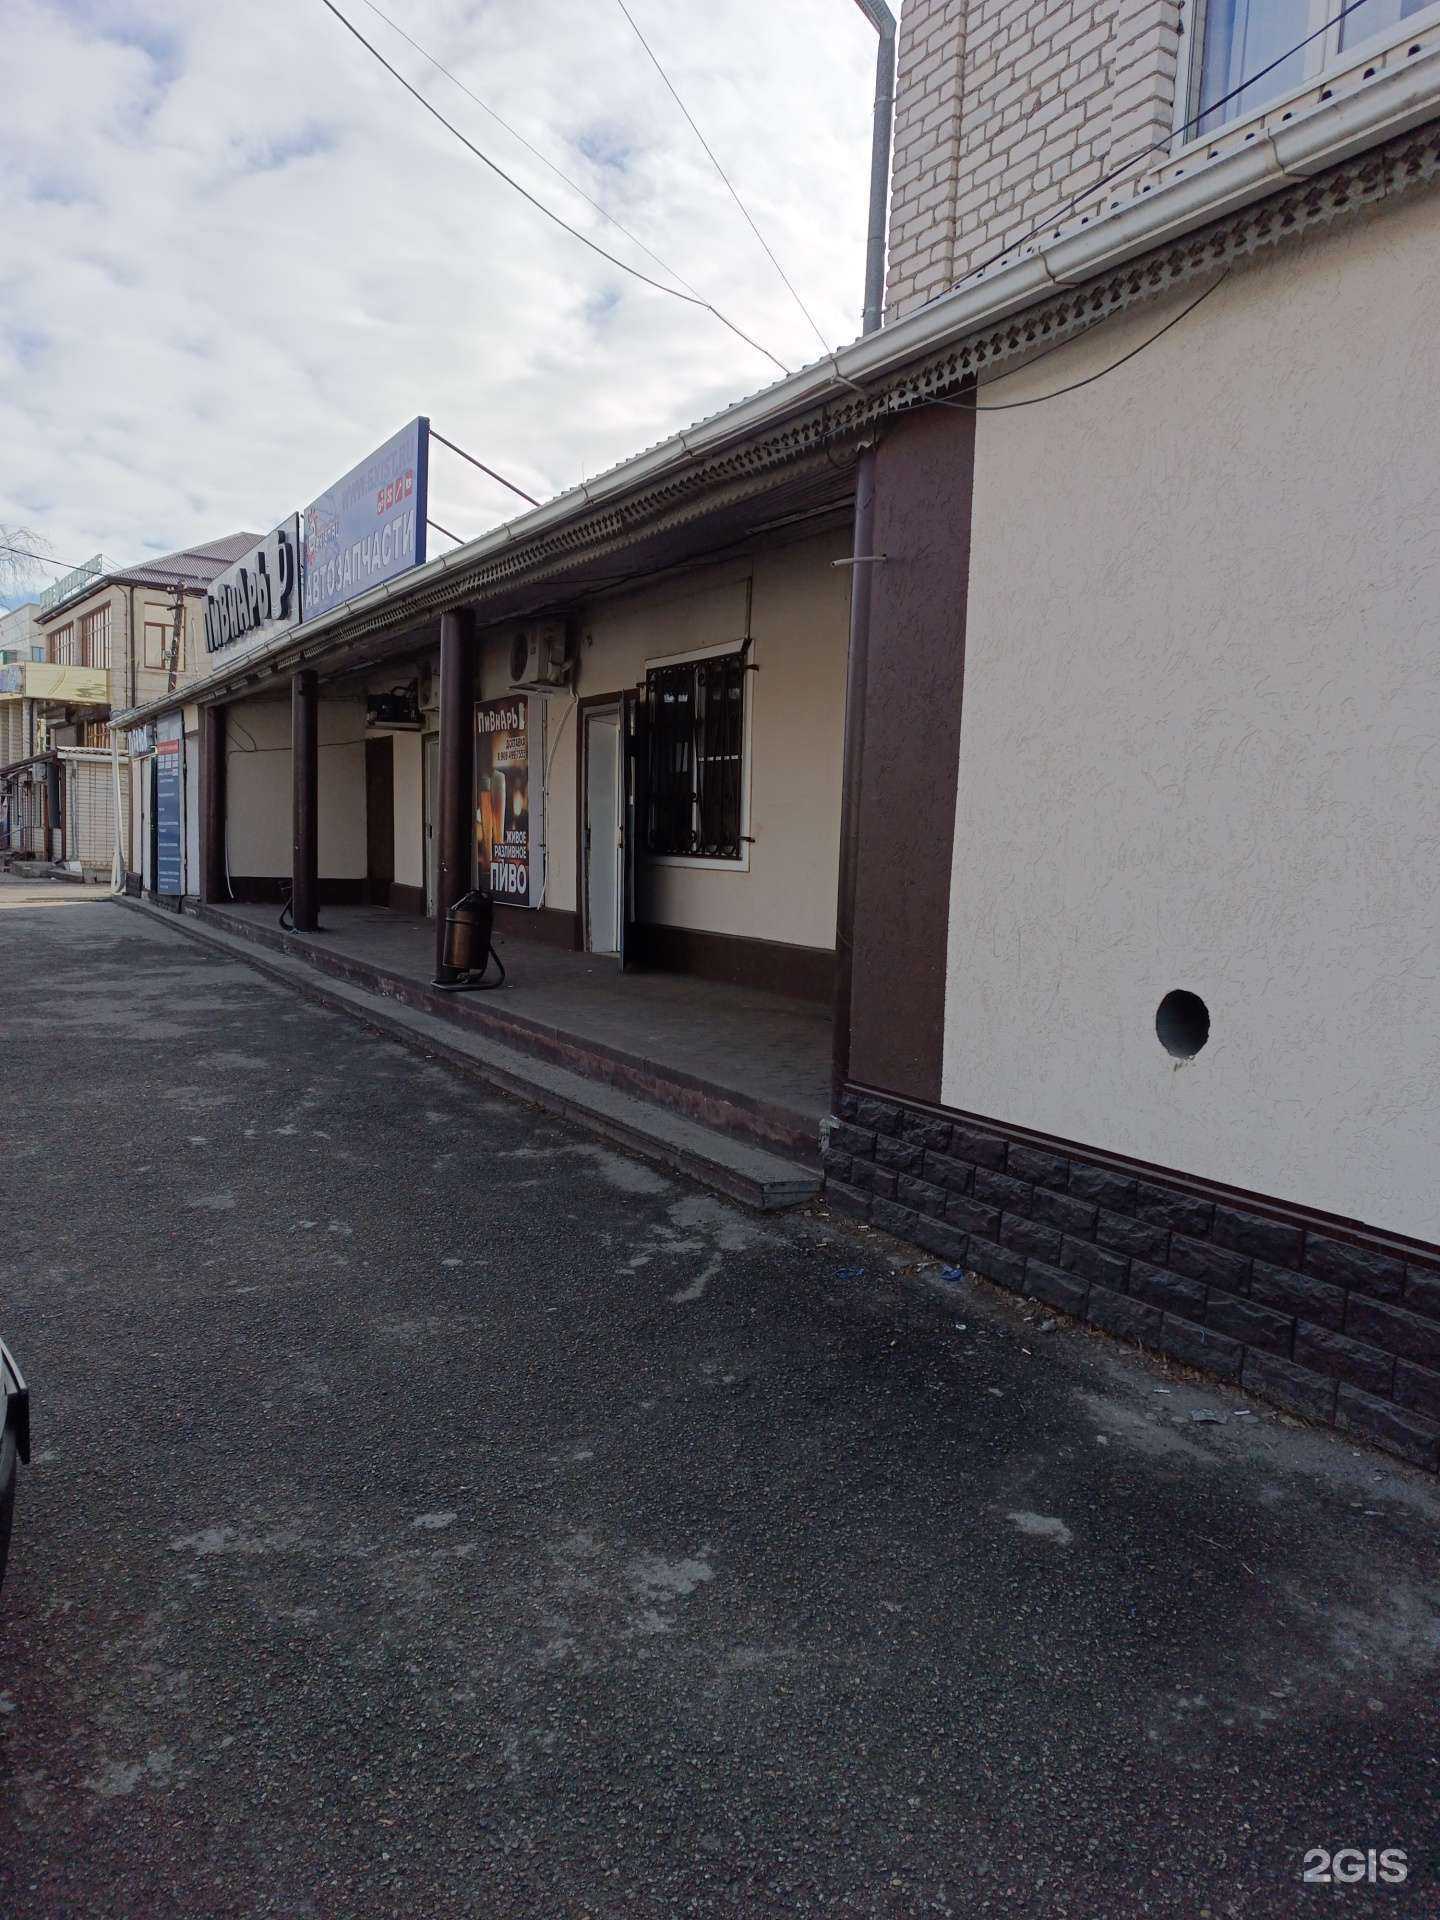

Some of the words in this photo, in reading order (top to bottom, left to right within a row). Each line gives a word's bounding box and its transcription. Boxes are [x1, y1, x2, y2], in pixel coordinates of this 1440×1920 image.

[306, 510, 415, 609] АВТОЗАПЧАСТИ
[506, 830, 527, 844] ЖИВОЕ
[494, 845, 527, 859] РАЗЛИВНОЕ
[490, 861, 527, 894] ПИВО
